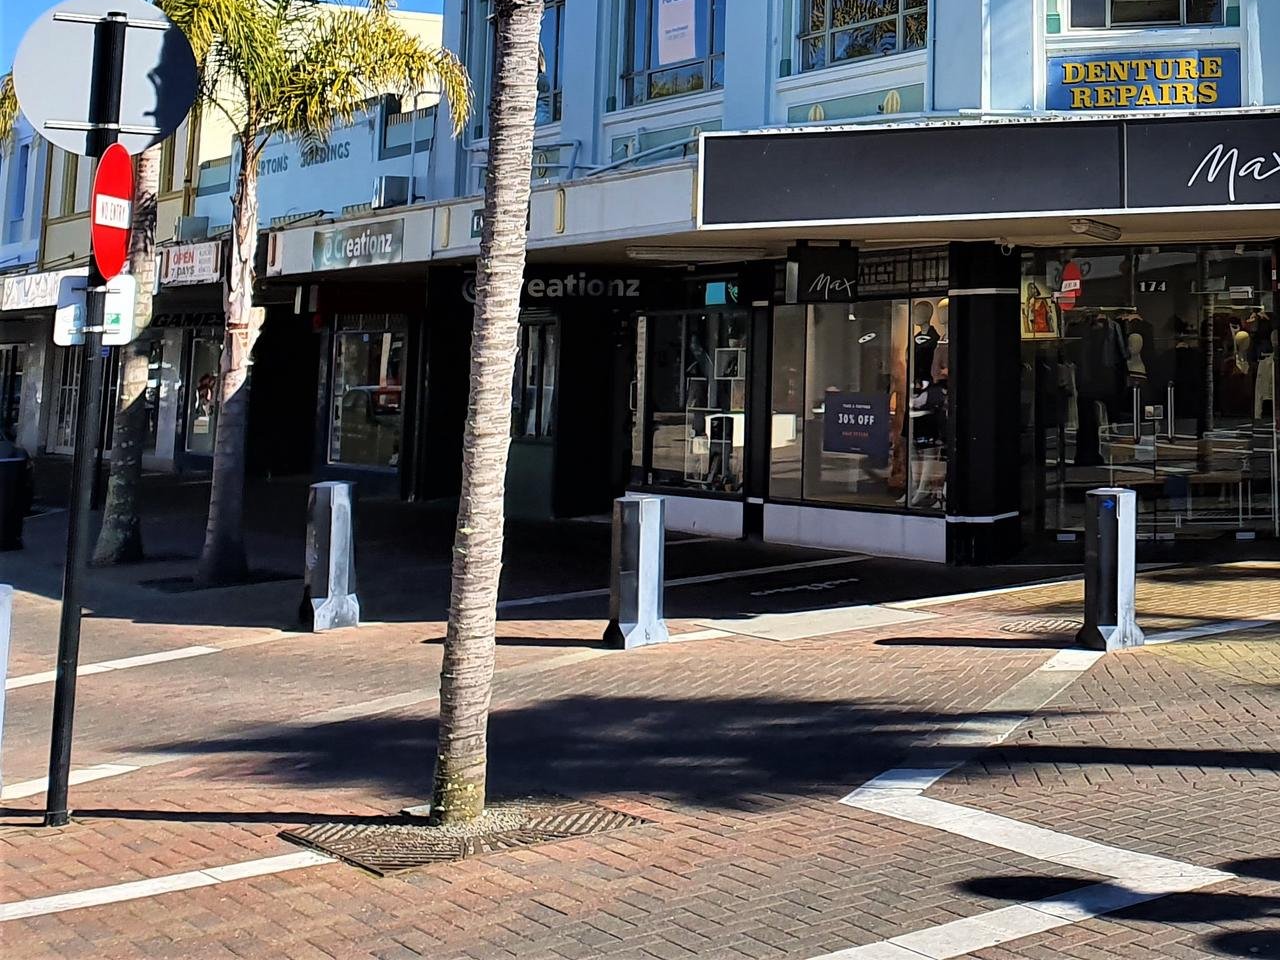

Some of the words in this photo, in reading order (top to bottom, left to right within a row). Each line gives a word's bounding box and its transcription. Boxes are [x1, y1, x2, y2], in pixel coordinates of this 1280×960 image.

[1062, 57, 1223, 84] DENTURE
[1070, 82, 1218, 109] REPAIRS
[172, 250, 195, 266] OPEN
[527, 271, 641, 298] eationz
[808, 272, 857, 300] Max
[1138, 281, 1167, 292] 174
[837, 413, 855, 425] 30%
[857, 414, 875, 426] OFF
